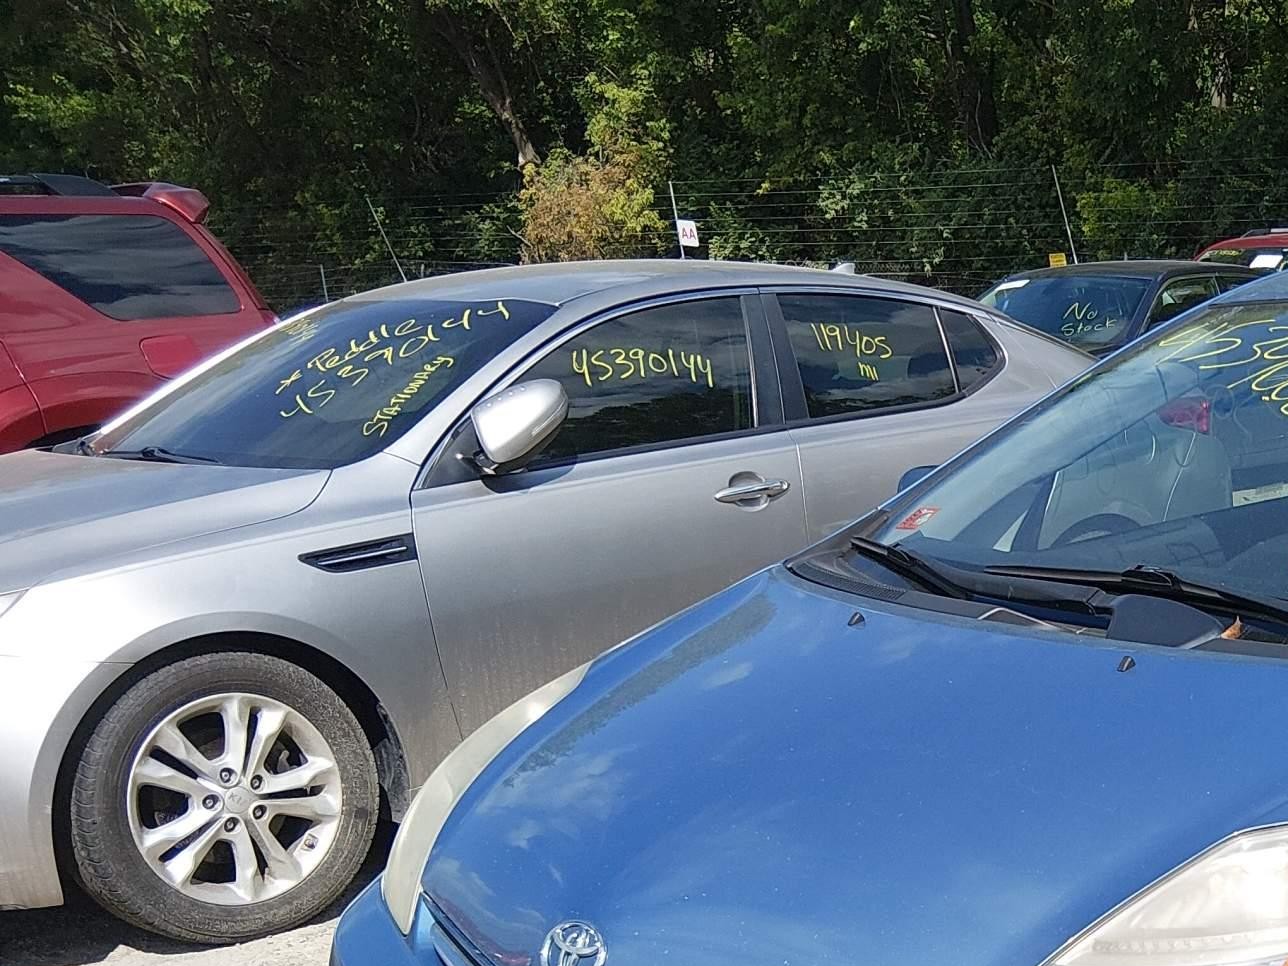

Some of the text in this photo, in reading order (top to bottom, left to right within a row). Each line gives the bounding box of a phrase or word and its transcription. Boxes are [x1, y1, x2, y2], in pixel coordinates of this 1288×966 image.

[681, 227, 696, 240] AA
[1061, 316, 1117, 336] Stock
[1063, 302, 1098, 320] No
[307, 319, 423, 372] Peddle
[810, 323, 892, 358] 119405
[280, 301, 509, 418] 45390144
[572, 348, 714, 388] 45390144
[362, 355, 454, 437] STATIONARY
